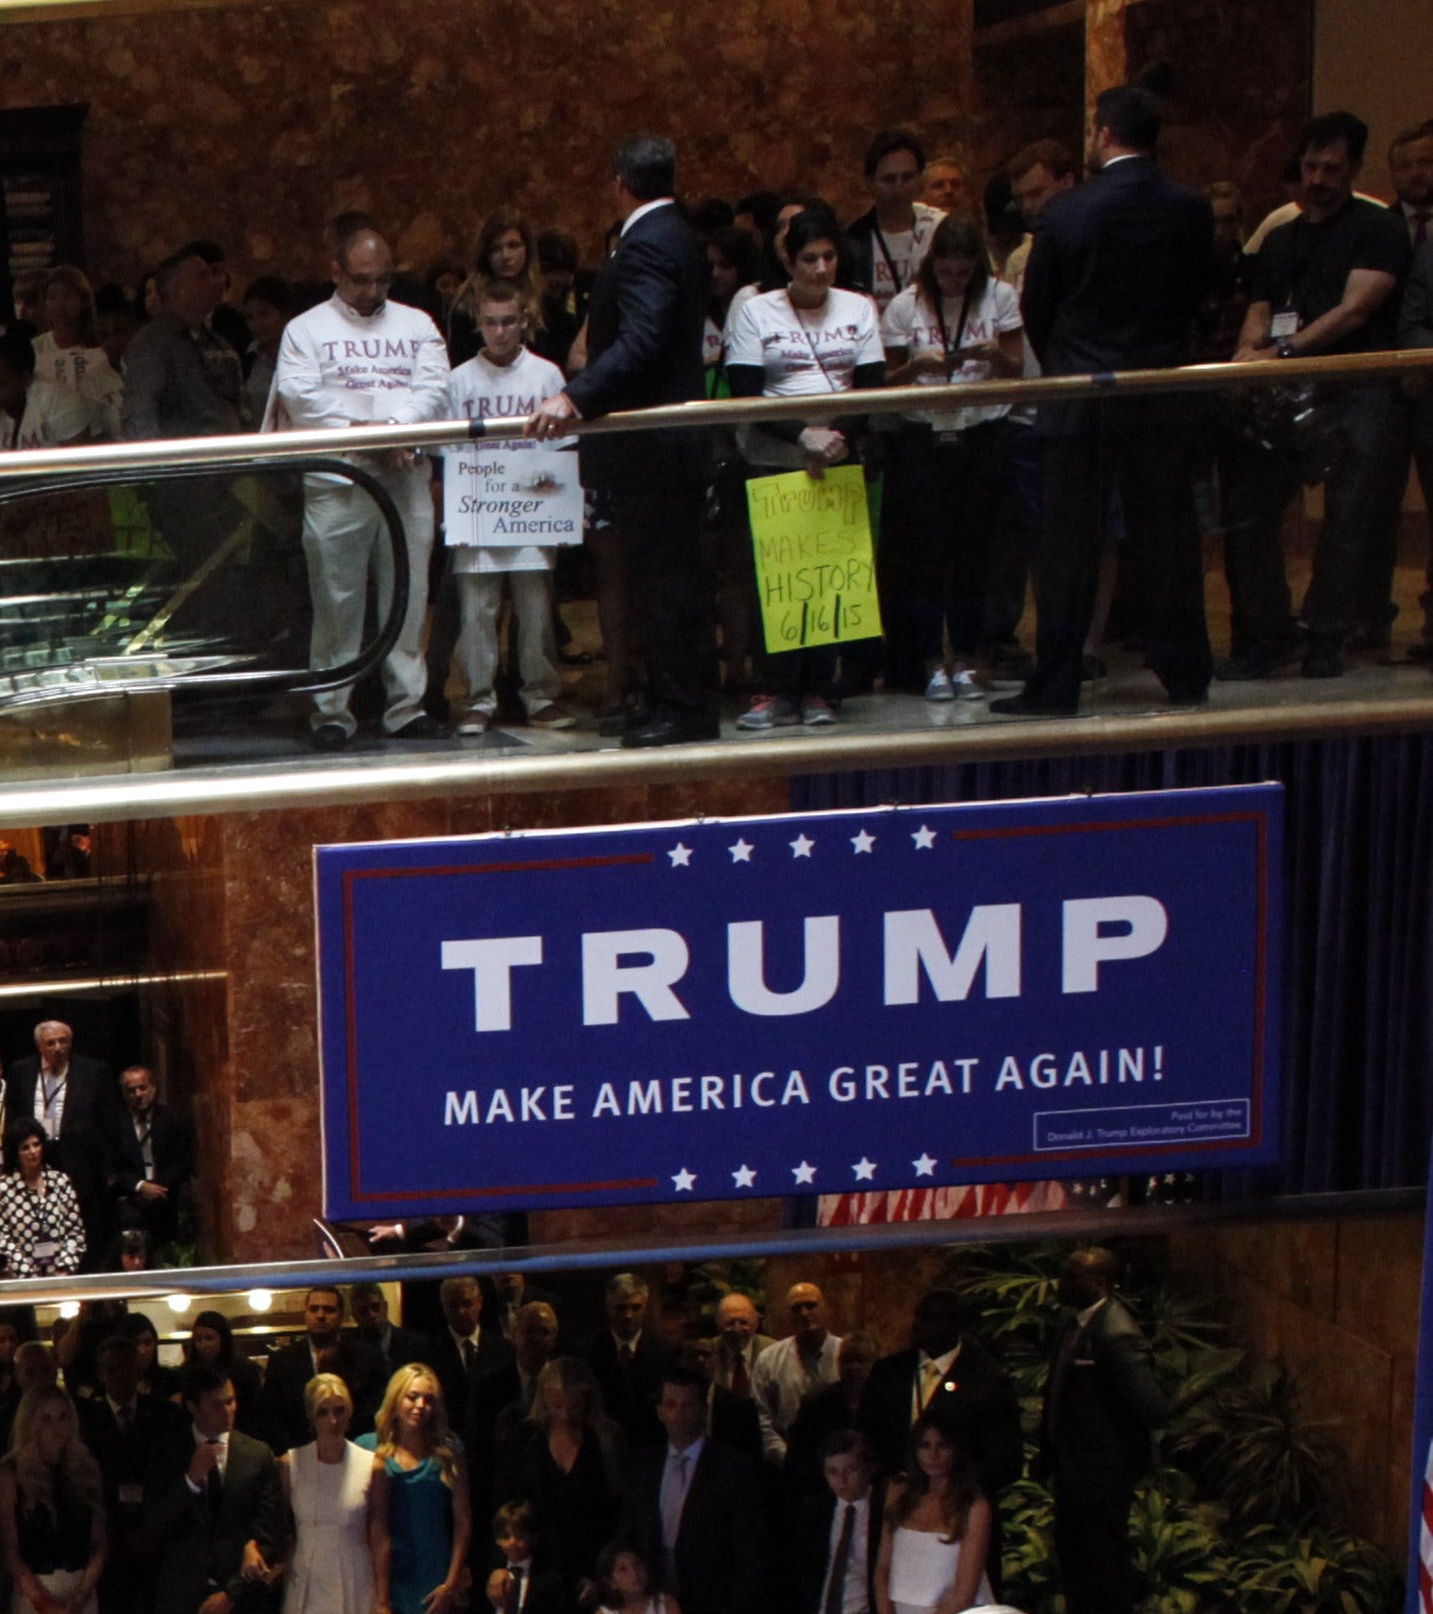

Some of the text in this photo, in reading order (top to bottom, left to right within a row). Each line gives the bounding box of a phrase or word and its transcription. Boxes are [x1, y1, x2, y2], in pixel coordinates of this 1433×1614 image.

[462, 393, 547, 419] TRUM
[458, 461, 506, 478] People
[485, 478, 521, 493] for a
[458, 495, 544, 518] Stronger
[493, 515, 575, 534] America
[759, 530, 857, 567] MAKES
[765, 558, 874, 607] HISTORY
[780, 594, 862, 646] 6/16/15
[442, 896, 1167, 1032] TRUMP
[445, 1047, 1162, 1126] MAKE AMERICA GREAT AGAIN!
[1171, 1110, 1194, 1121] Paid
[1195, 1109, 1209, 1120] for
[1047, 1131, 1084, 1142] Donald
[1096, 1127, 1128, 1139] Trump
[1130, 1124, 1186, 1138] Exploratory
[1187, 1119, 1243, 1133] Committee
